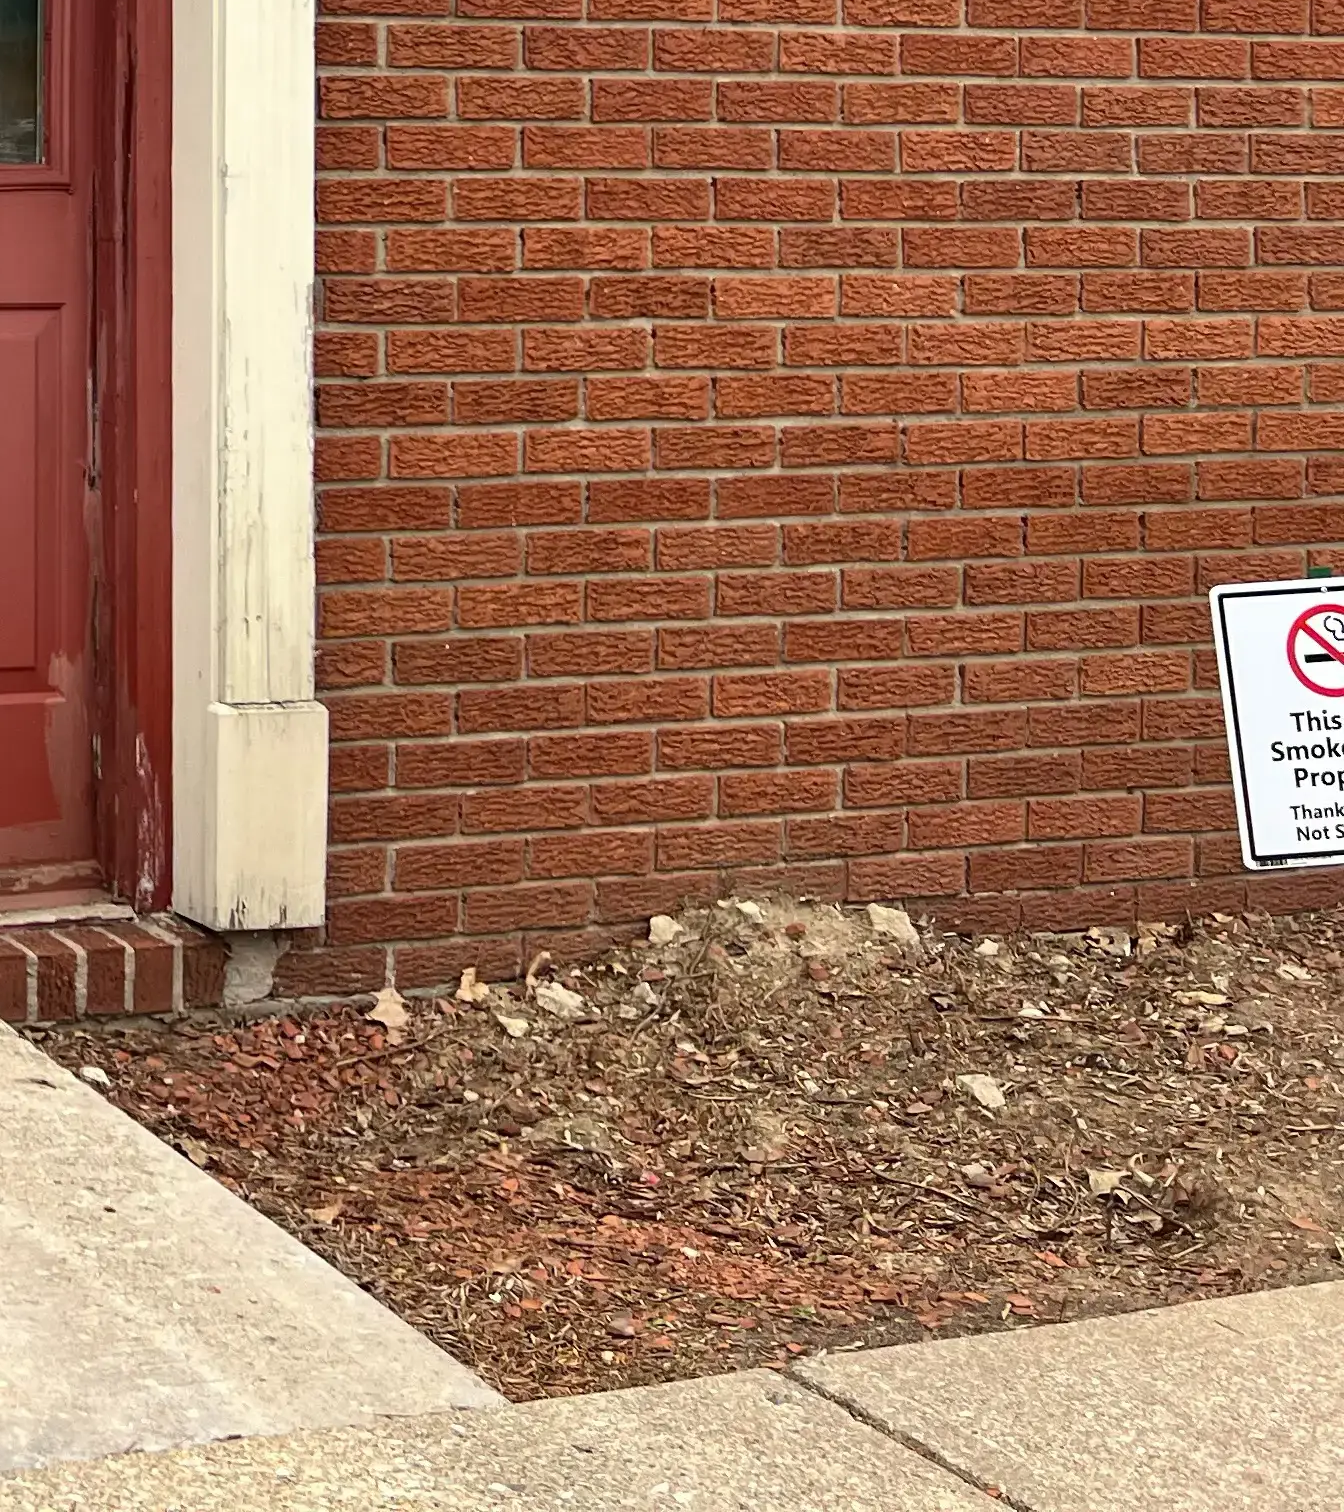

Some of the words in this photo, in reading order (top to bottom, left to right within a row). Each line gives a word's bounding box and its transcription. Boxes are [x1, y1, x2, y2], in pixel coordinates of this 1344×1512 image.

[1289, 709, 1342, 732] This
[1271, 736, 1344, 762] Smok
[1296, 825, 1330, 841] Not
